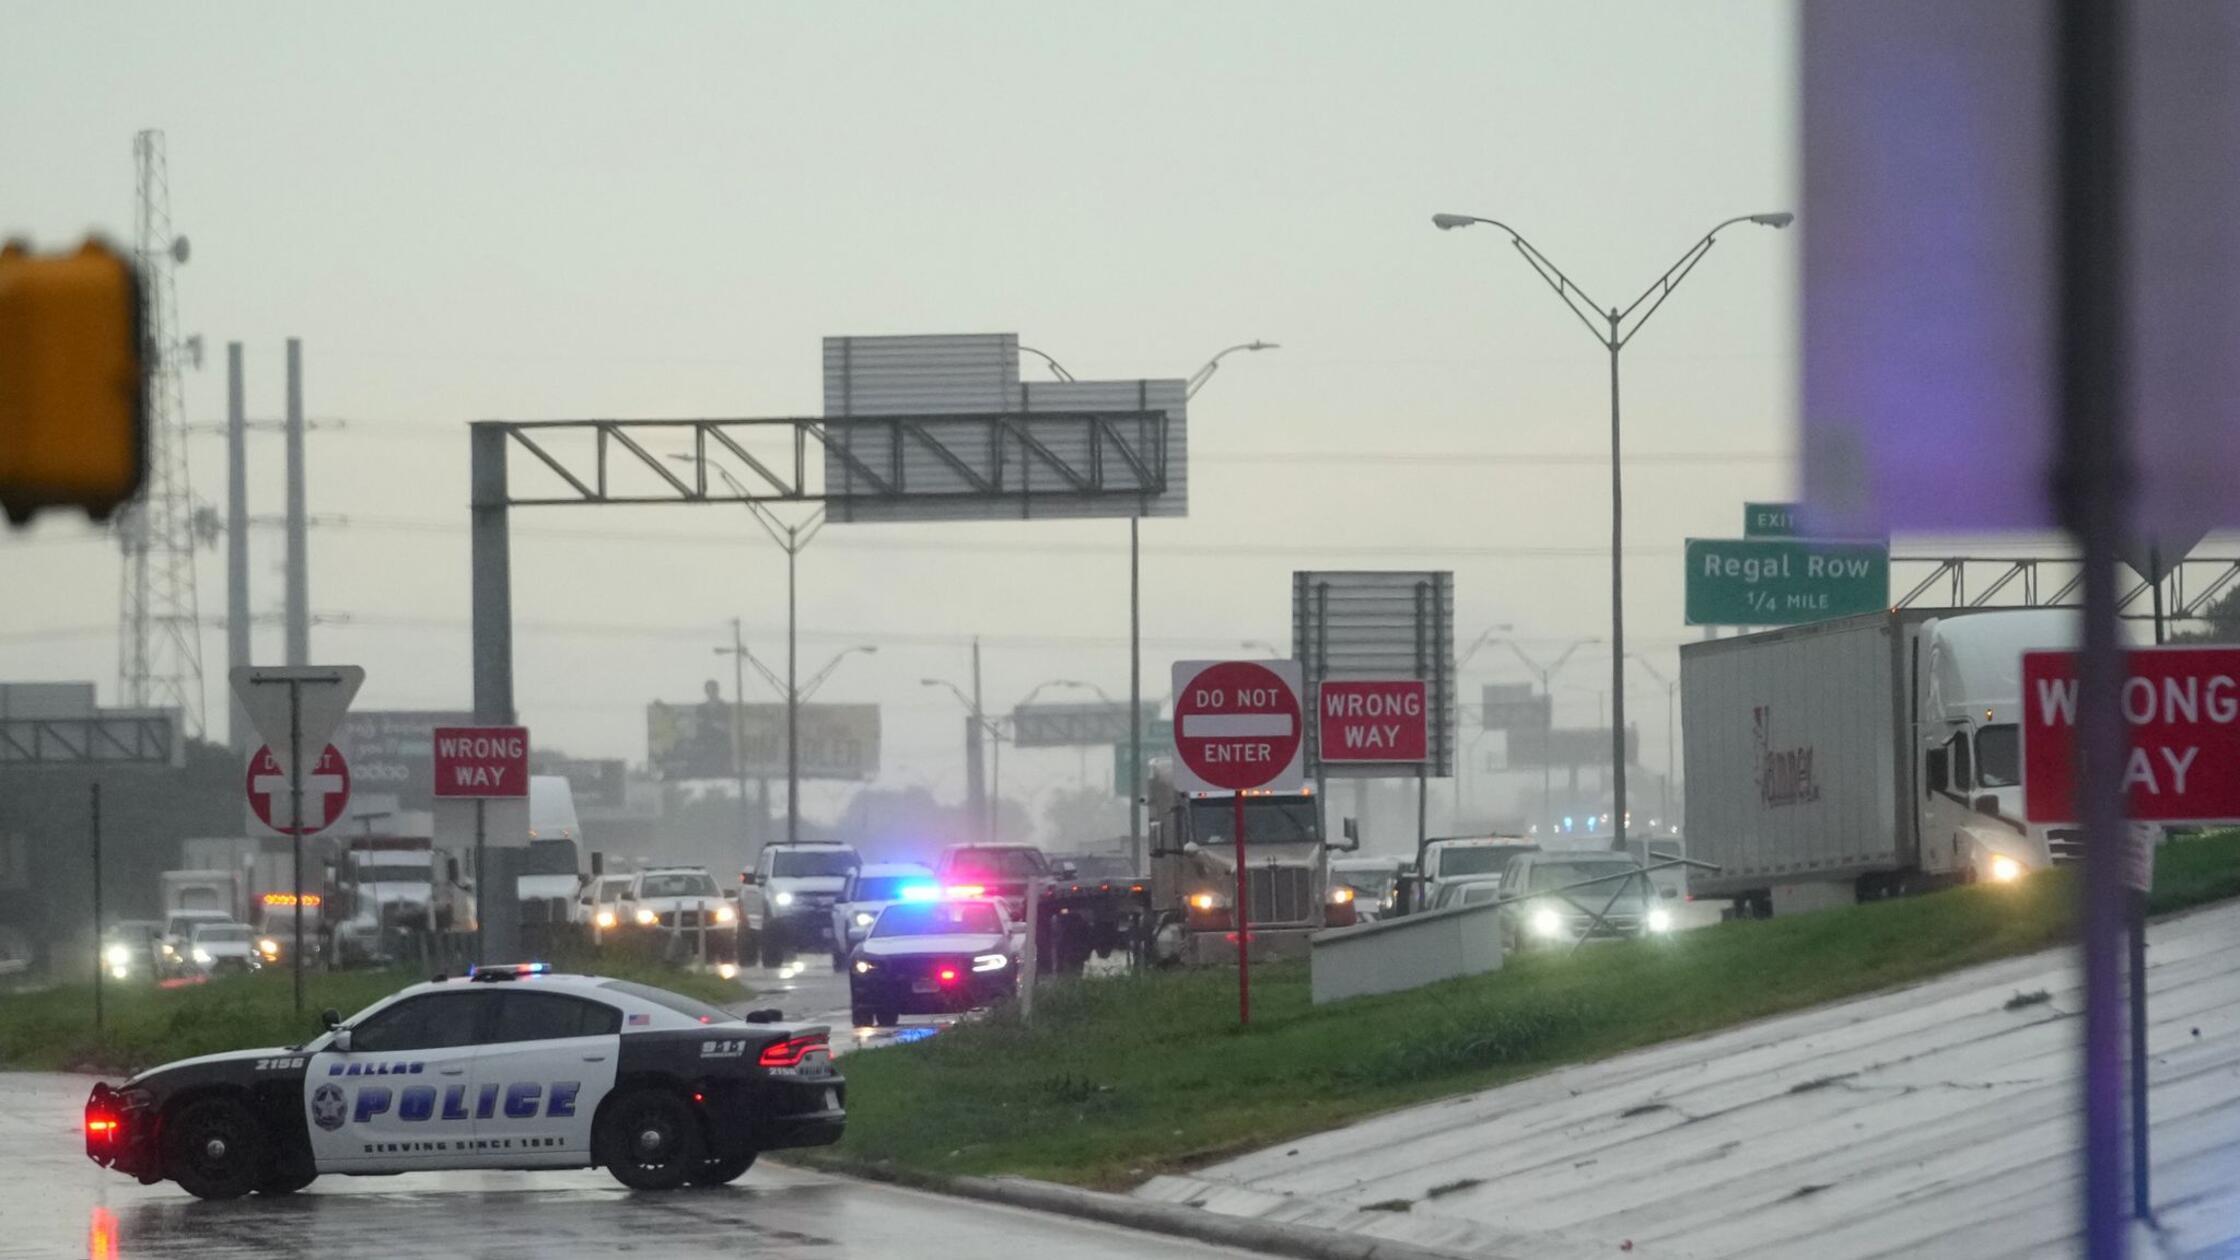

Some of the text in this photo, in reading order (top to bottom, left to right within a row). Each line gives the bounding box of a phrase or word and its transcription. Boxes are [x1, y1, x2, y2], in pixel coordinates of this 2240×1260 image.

[1704, 553, 1870, 583] Regal Row
[1786, 594, 1830, 609] MILE
[1196, 688, 1280, 709] DO NOT
[1326, 693, 1421, 718] WRONG
[2036, 674, 2239, 727] WONG
[1345, 724, 1401, 748] WAY
[439, 737, 523, 759] WRONG
[1204, 743, 1272, 763] ENTER
[455, 766, 506, 787] WAY
[2121, 746, 2200, 795] AY
[328, 1062, 425, 1076] DALLAS
[353, 1080, 582, 1123] POLICE
[363, 1141, 447, 1153] SERVING
[455, 1138, 512, 1150] SINCE
